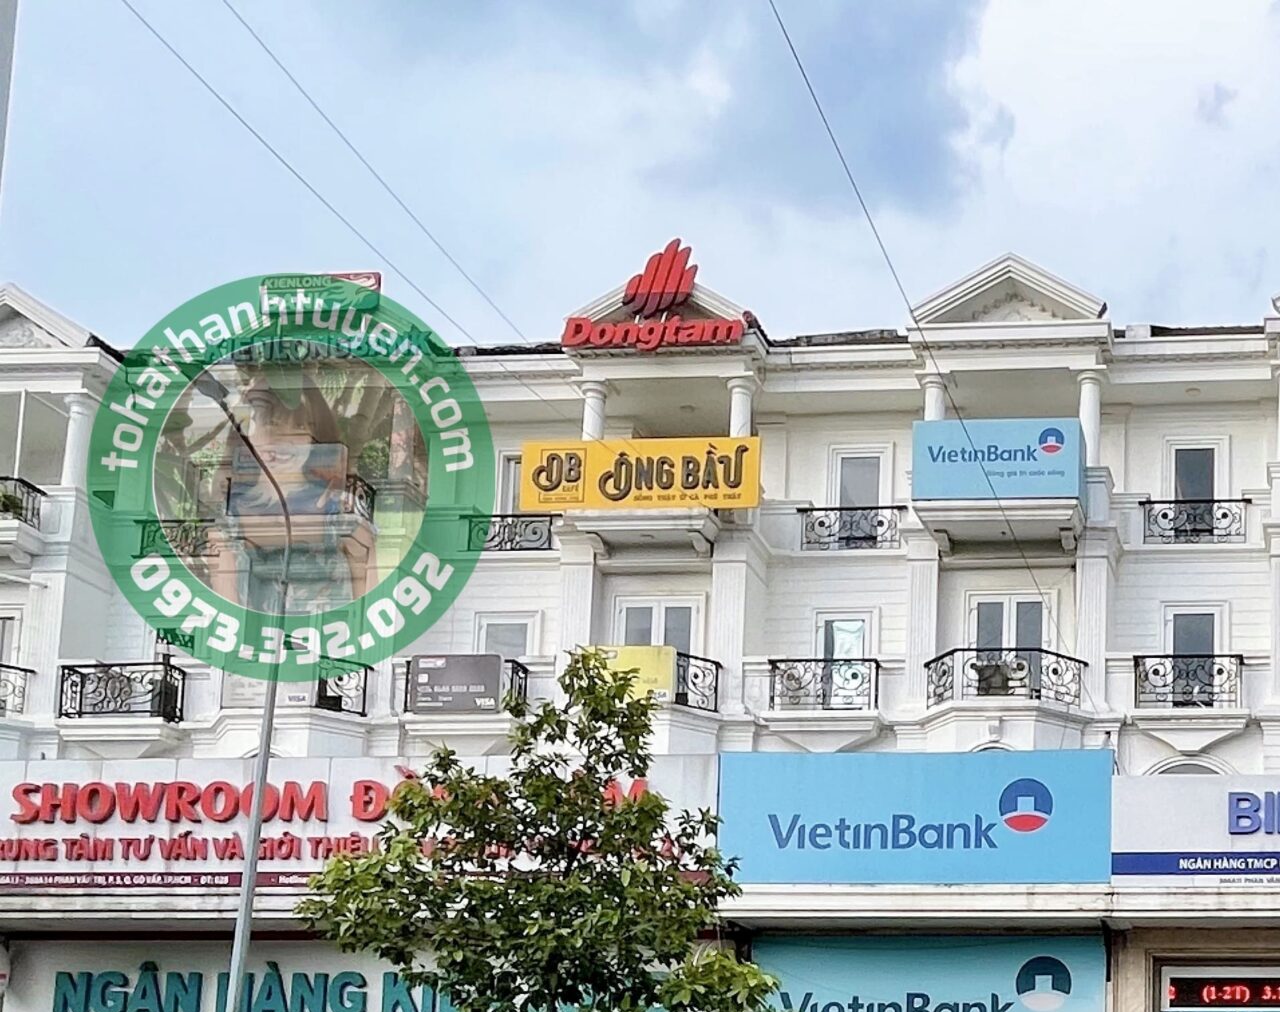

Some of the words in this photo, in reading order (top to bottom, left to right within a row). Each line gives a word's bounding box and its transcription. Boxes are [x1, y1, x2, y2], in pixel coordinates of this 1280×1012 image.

[561, 314, 744, 352] Dongtam
[598, 451, 675, 501] ÔNG
[681, 442, 749, 491] BẦU
[927, 444, 1038, 463] VietinBank
[10, 781, 328, 824] SHOWROOM
[767, 814, 999, 850] VietinBank
[1247, 856, 1277, 868] TMCP
[1202, 984, 1250, 1004] (1-2T)
